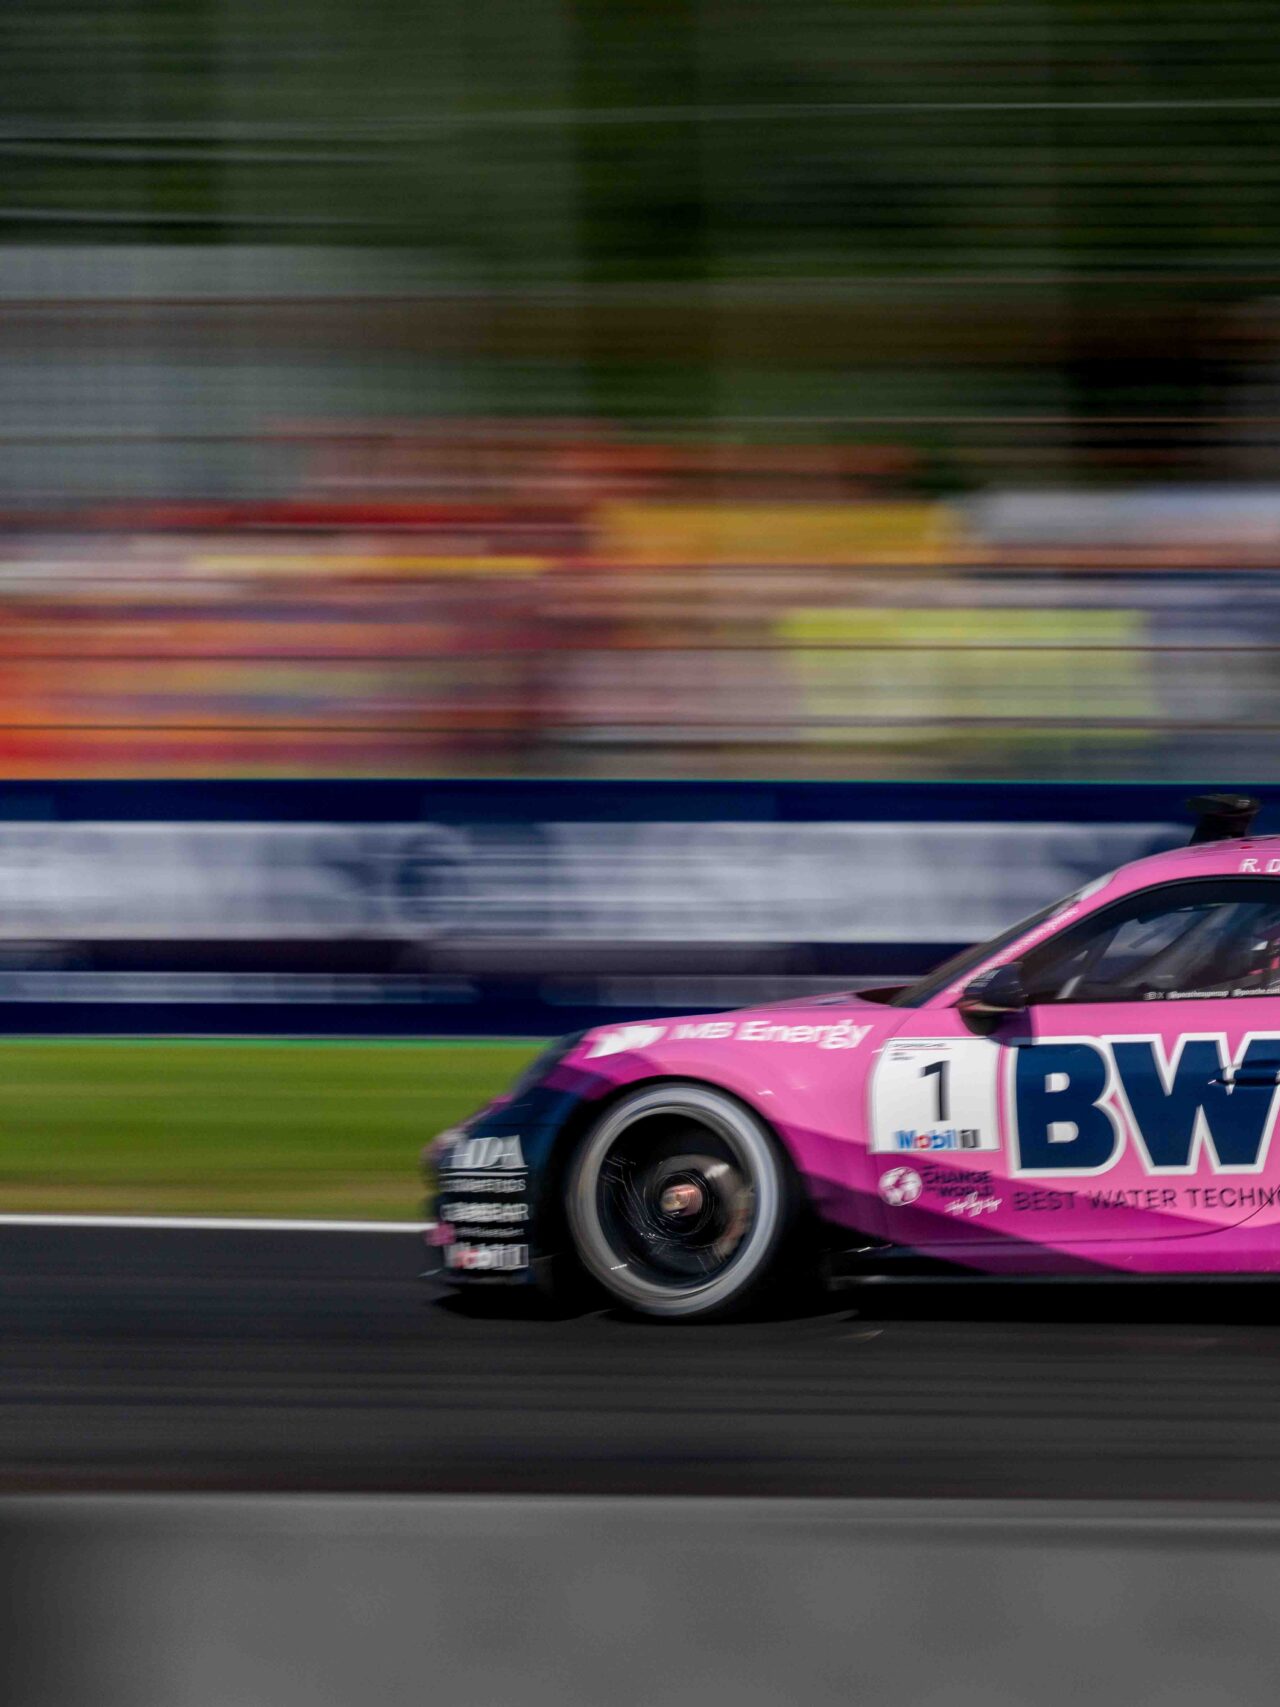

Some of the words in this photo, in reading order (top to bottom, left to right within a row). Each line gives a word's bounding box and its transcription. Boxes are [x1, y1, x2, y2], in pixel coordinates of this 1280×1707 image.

[1240, 858, 1262, 873] R.
[736, 1019, 874, 1050] Energy
[918, 1059, 951, 1121] 1
[894, 1129, 957, 1149] Mobil
[1013, 1191, 1079, 1211] BEST
[1087, 1189, 1178, 1209] WATER
